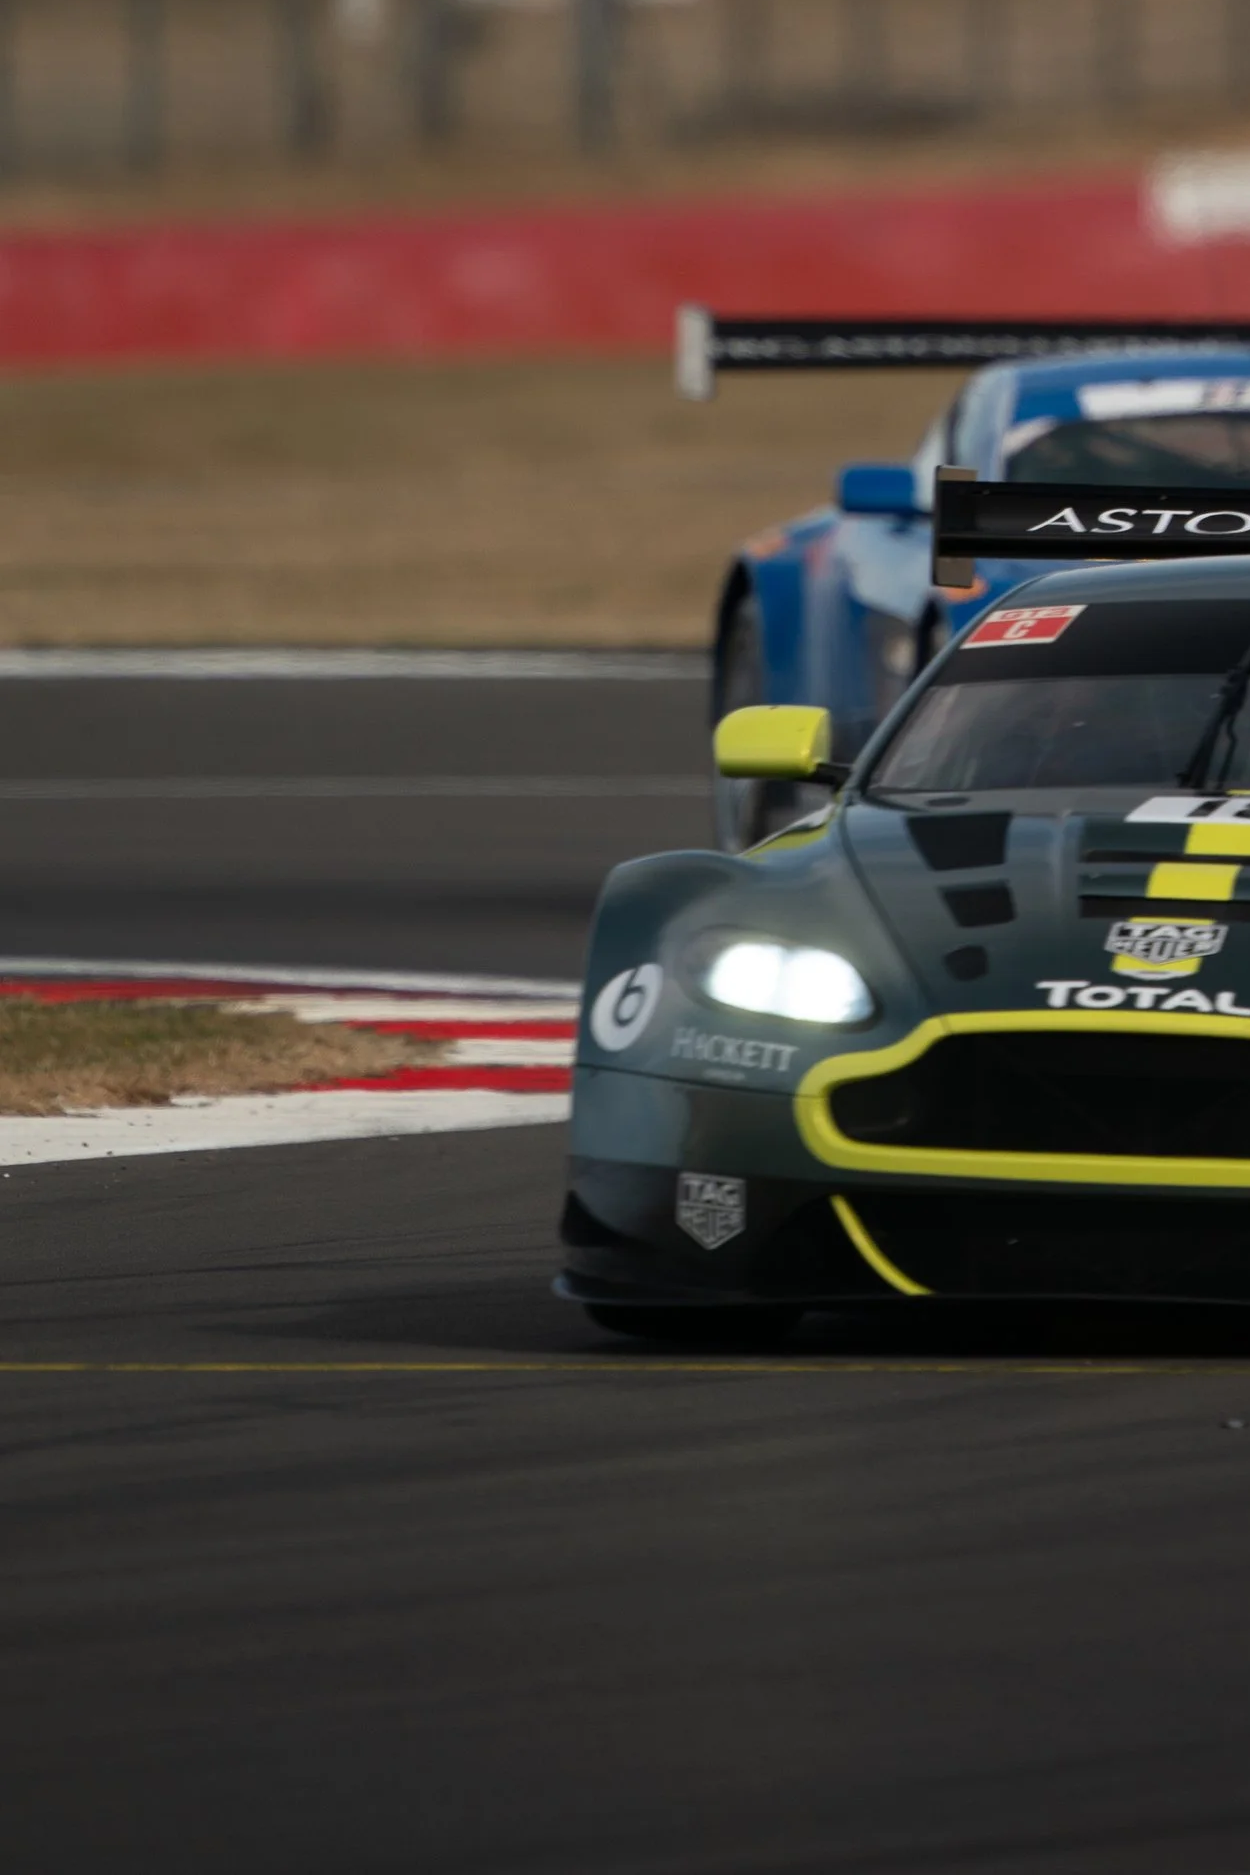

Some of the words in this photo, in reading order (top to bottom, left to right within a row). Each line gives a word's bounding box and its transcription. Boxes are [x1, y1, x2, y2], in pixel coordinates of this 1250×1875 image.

[1003, 619, 1037, 639] C
[1118, 925, 1215, 940] TAG
[1112, 940, 1213, 962] HEUER
[670, 1027, 800, 1071] HACKETT
[684, 1179, 741, 1205] TAG
